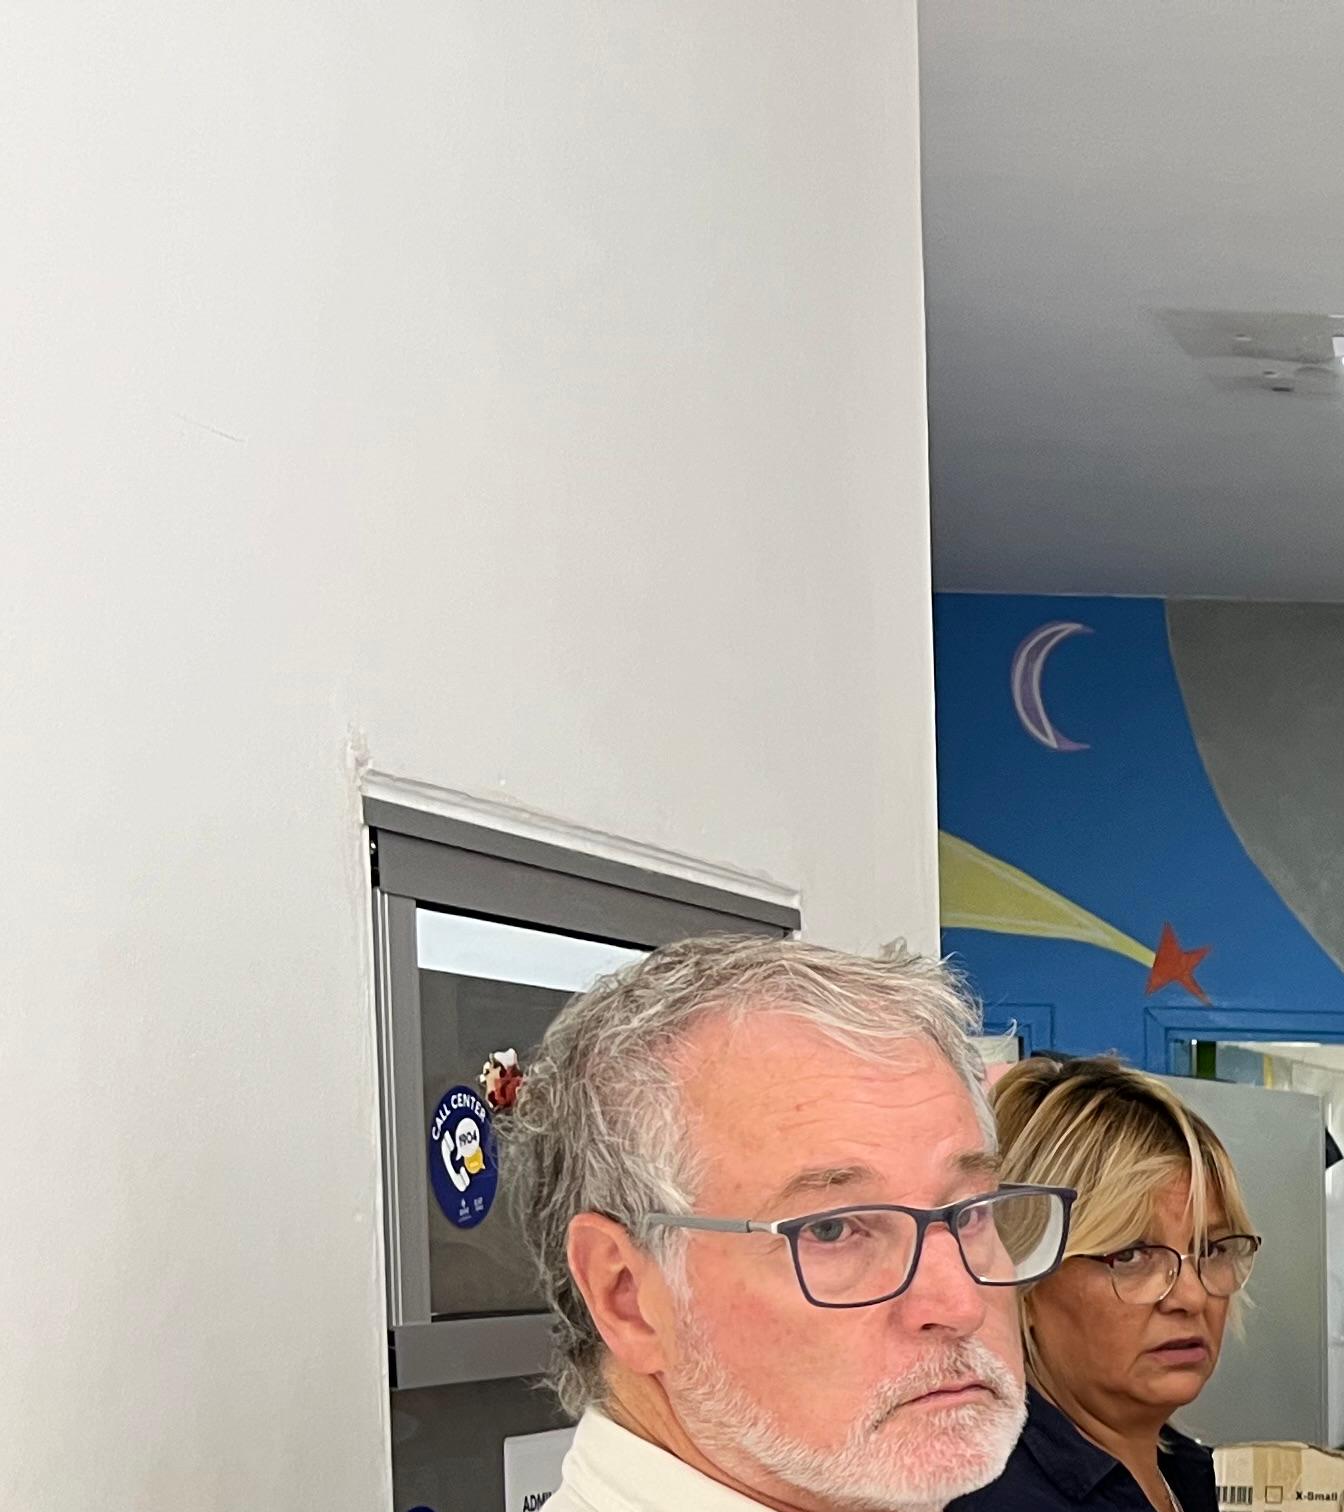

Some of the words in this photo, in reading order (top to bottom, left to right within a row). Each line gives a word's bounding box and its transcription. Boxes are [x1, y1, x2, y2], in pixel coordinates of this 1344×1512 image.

[431, 1103, 451, 1140] CALL
[450, 1093, 487, 1123] CENTER
[1296, 1491, 1338, 1501] X-Small
